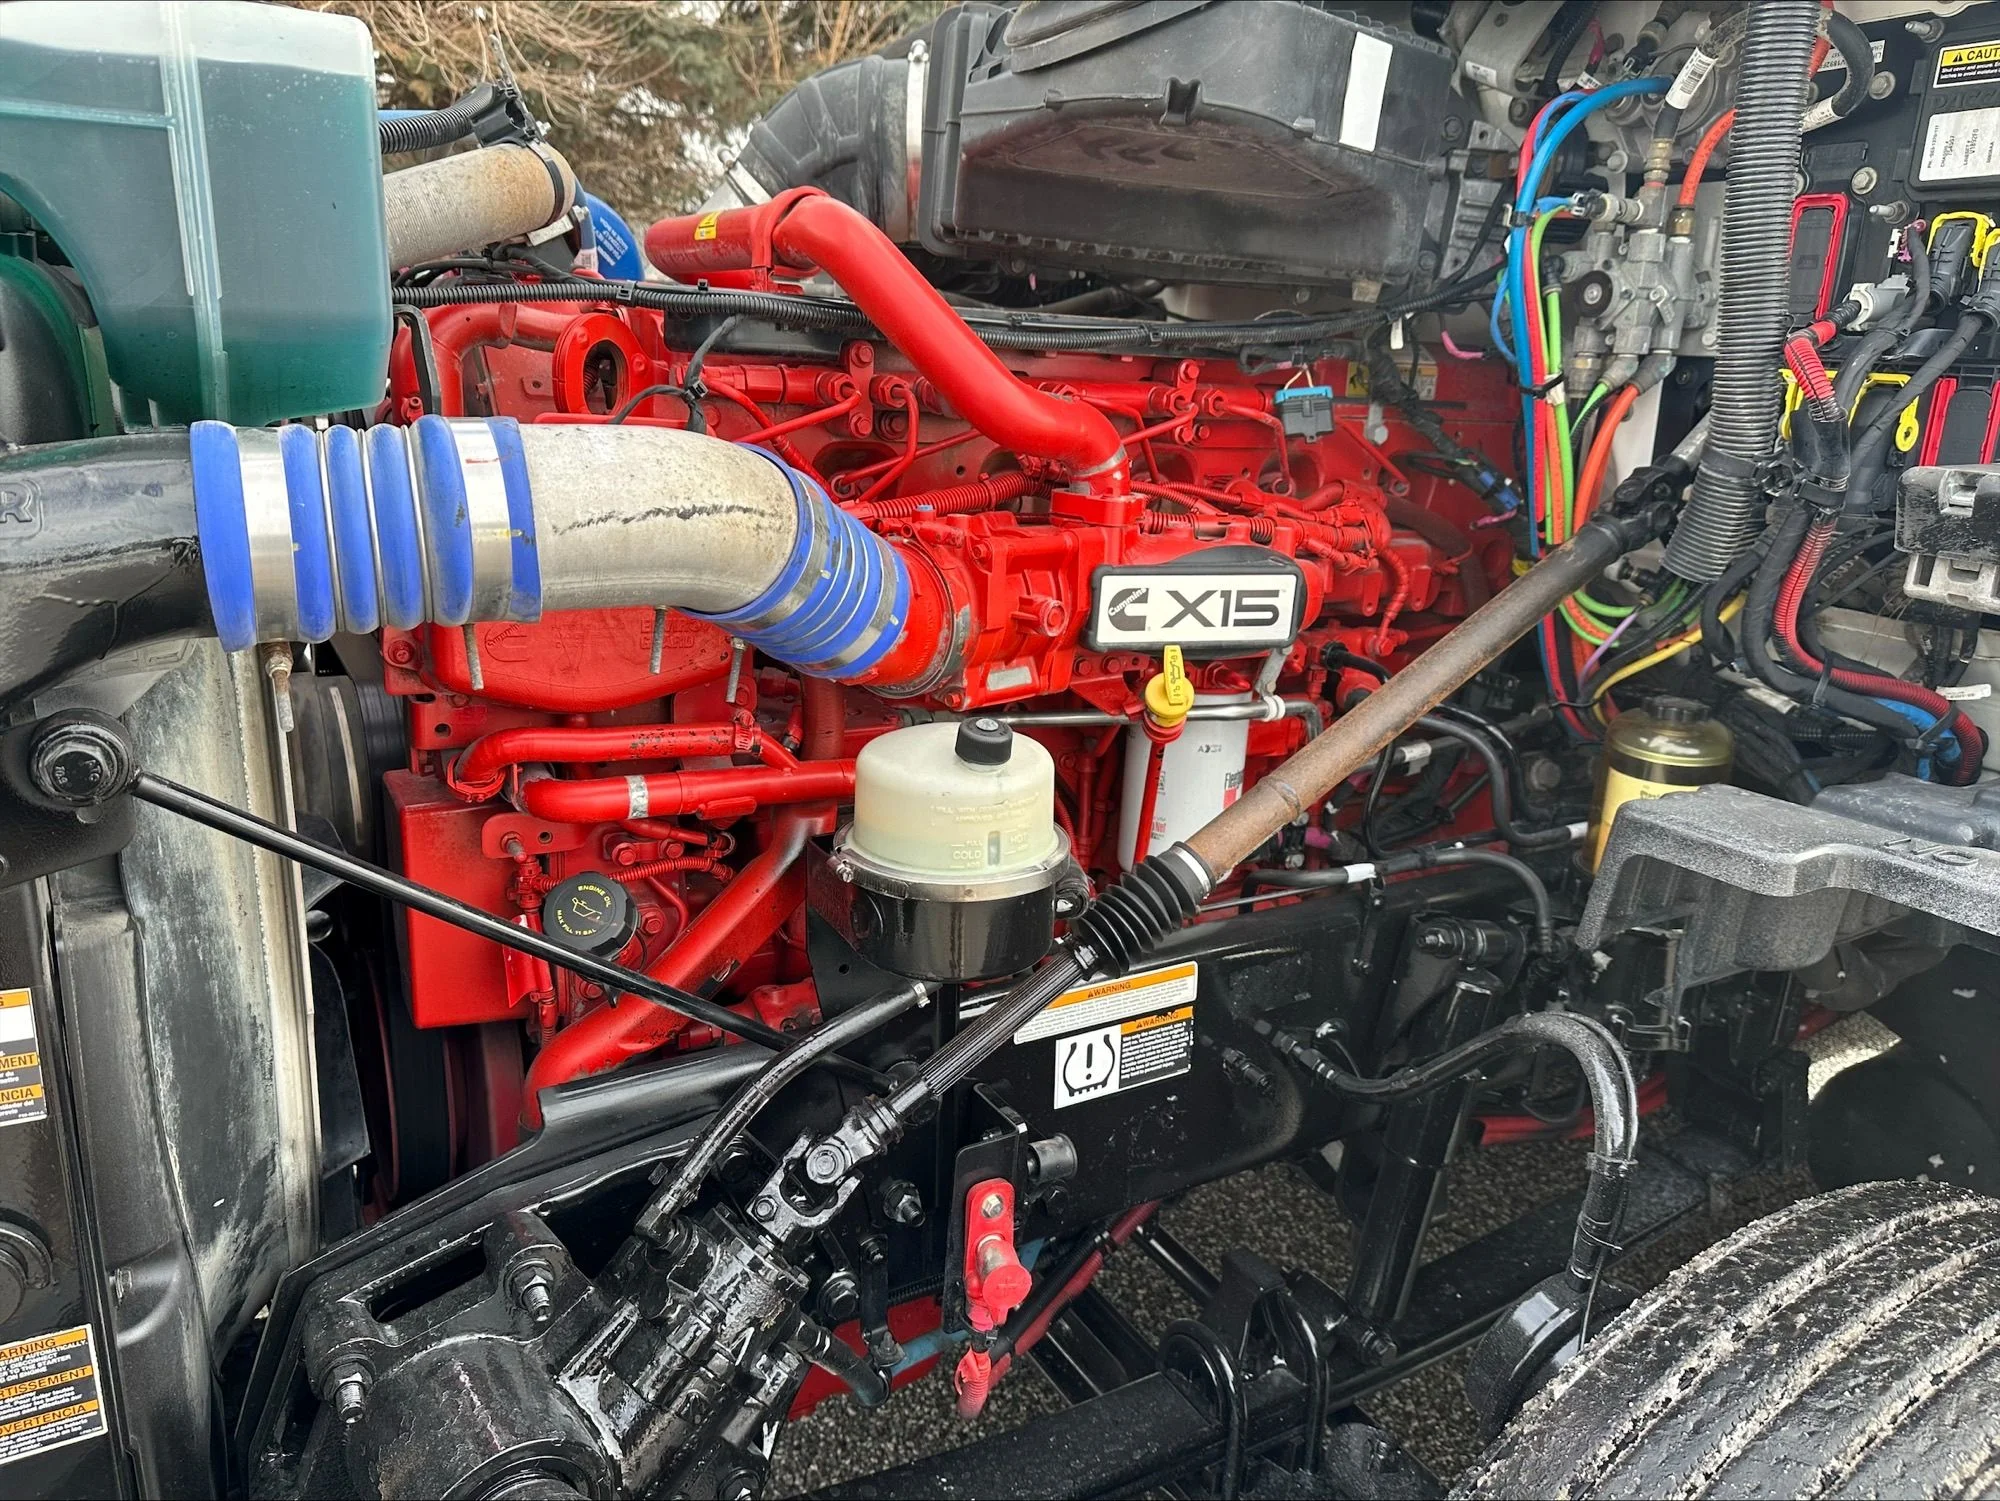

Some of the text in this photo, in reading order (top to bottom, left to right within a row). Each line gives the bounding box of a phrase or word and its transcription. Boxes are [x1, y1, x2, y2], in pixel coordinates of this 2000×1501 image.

[1966, 48, 2000, 61] CAUT
[1161, 590, 1280, 628] X15
[953, 850, 982, 860] COLD
[578, 885, 612, 908] ENGINE OIL
[1094, 982, 1132, 997] WARNING
[1142, 1013, 1179, 1025] WARNING
[0, 1054, 34, 1070] MENT
[1, 1088, 34, 1102] NCIA
[0, 1338, 56, 1360] ARNING
[10, 1353, 57, 1369] DISCONNECT
[37, 1354, 71, 1368] STARTER
